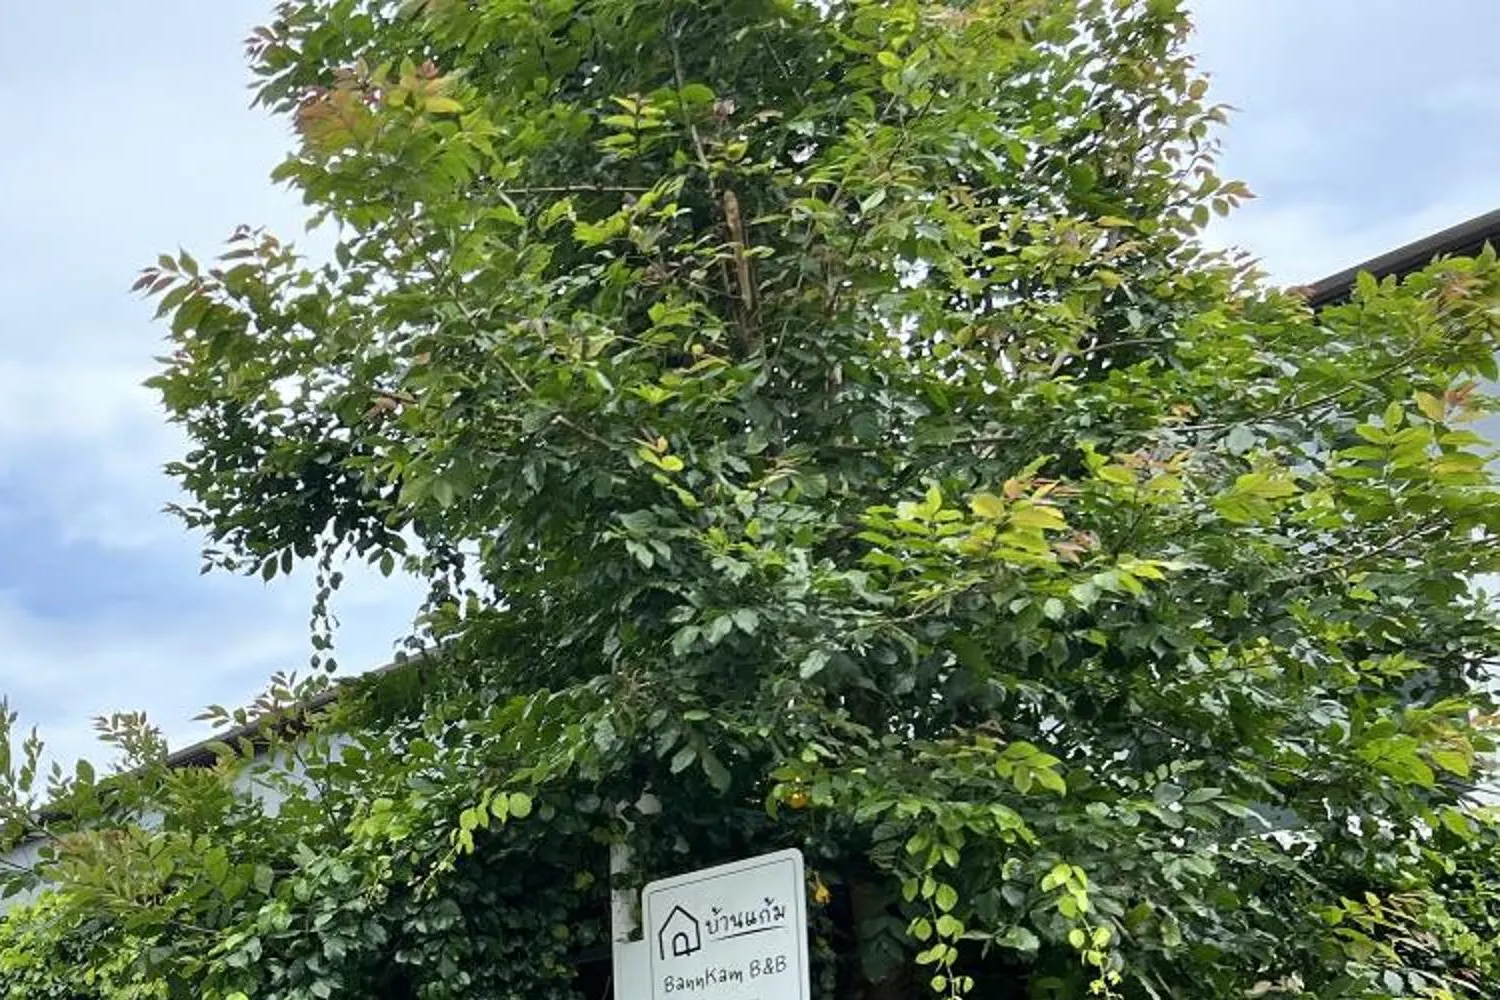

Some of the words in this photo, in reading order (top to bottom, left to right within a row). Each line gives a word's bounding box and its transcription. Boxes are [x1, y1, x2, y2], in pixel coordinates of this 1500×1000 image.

[705, 897, 786, 935] บ้านแก้ม
[749, 955, 787, 979] B&B
